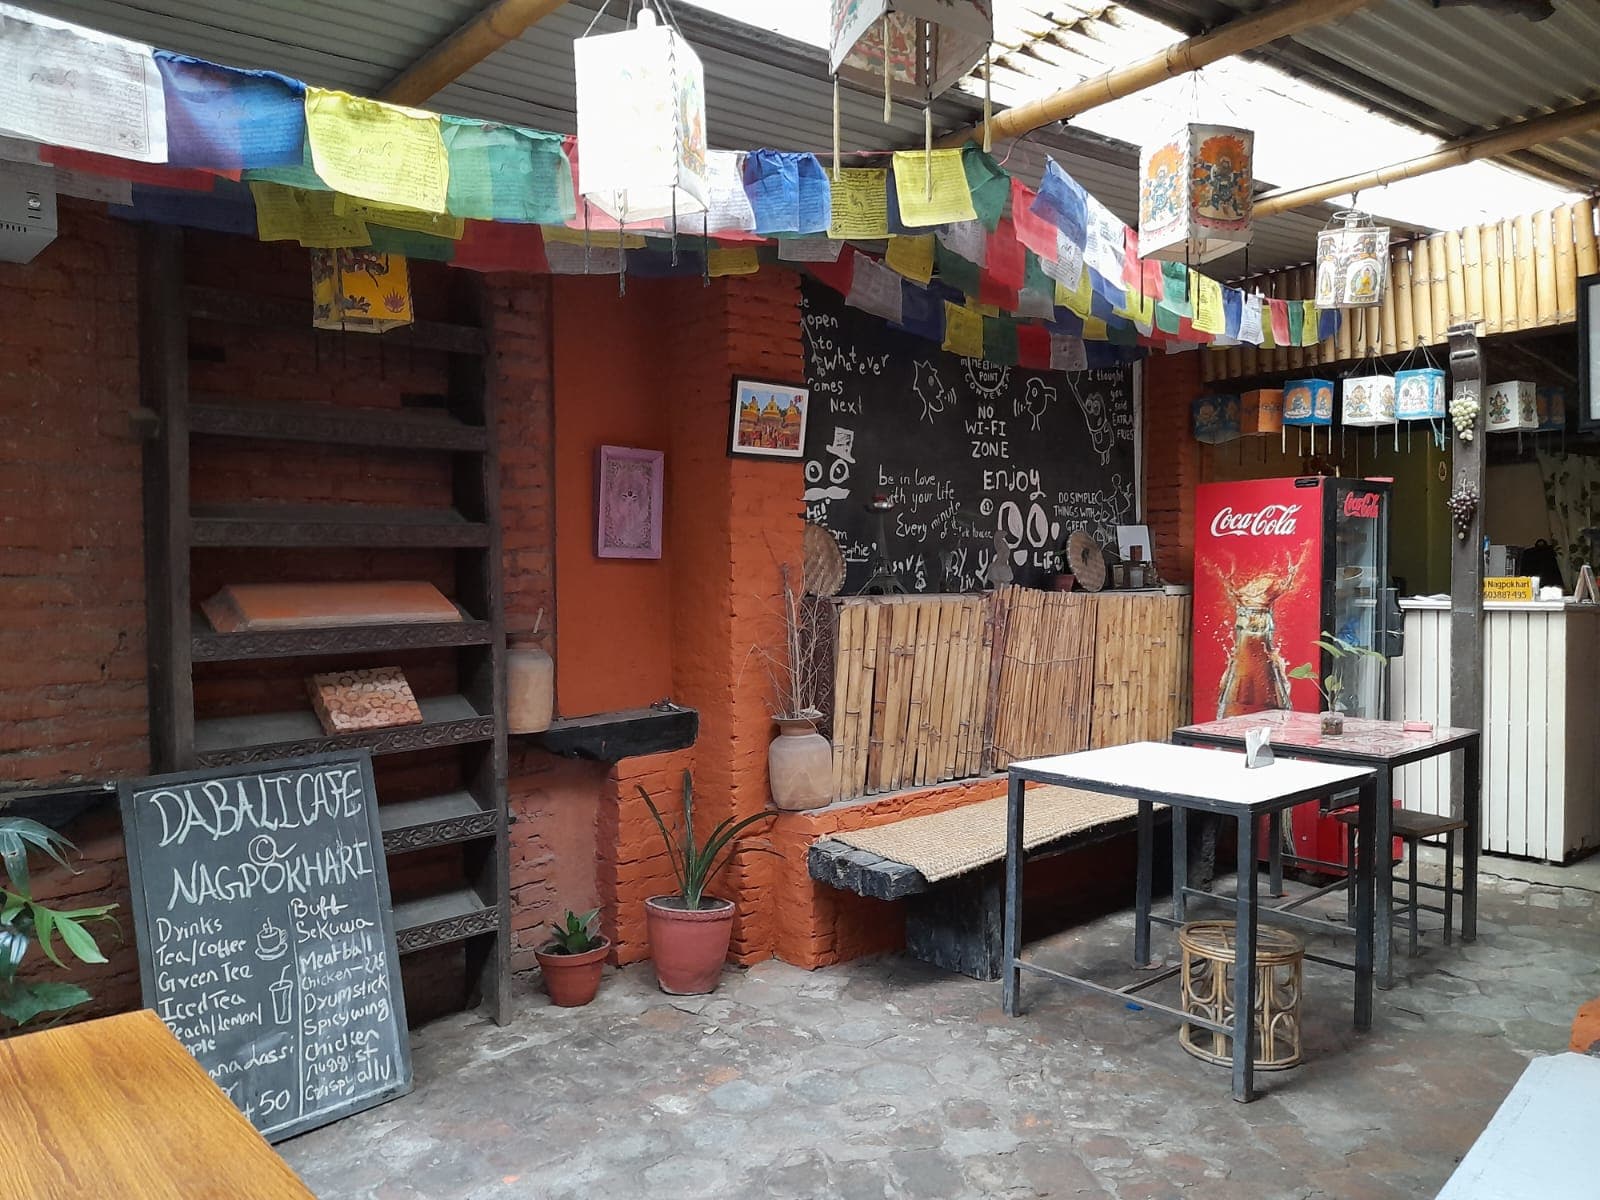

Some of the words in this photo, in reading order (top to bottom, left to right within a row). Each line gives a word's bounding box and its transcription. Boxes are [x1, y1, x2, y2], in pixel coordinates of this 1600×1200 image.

[806, 313, 839, 330] open
[978, 371, 998, 383] POINT
[977, 405, 994, 419] NO
[965, 419, 1006, 437] WI-FI
[971, 441, 1009, 458] ZONE
[900, 473, 911, 485] in
[915, 467, 936, 486] love
[910, 492, 933, 514] your
[1058, 491, 1069, 504] DO
[1070, 491, 1096, 504] SIMPLE
[1052, 504, 1079, 518] THINGS
[1065, 519, 1088, 533] GREAT
[1210, 504, 1302, 537] Coca-Cola
[1487, 580, 1529, 590] Nagpokhari
[149, 775, 300, 847] DABALI
[296, 769, 362, 826] CAFE
[167, 840, 373, 911] NAGPOKHARI
[156, 917, 223, 943] Drinks
[158, 971, 219, 993] Green
[220, 961, 254, 983] Tea
[158, 992, 209, 1021] Iced
[208, 989, 247, 1010] Tea
[259, 1089, 291, 1116] 50
